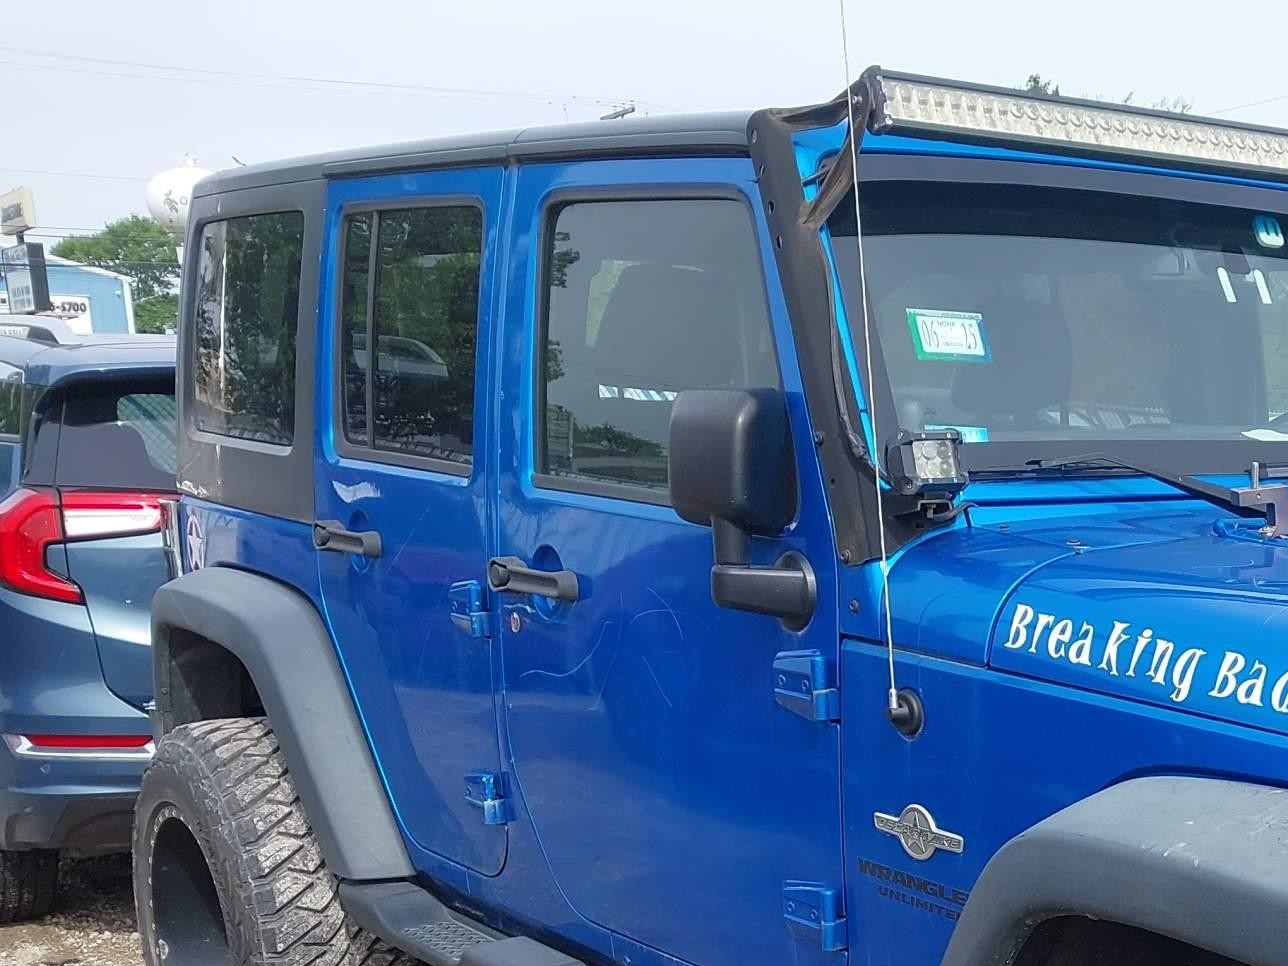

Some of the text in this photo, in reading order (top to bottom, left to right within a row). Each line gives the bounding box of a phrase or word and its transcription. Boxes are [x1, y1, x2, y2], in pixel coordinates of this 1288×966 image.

[1004, 603, 1207, 702] Breaking
[858, 857, 971, 906] WRANGLE
[877, 884, 961, 920] UNLIMITE
